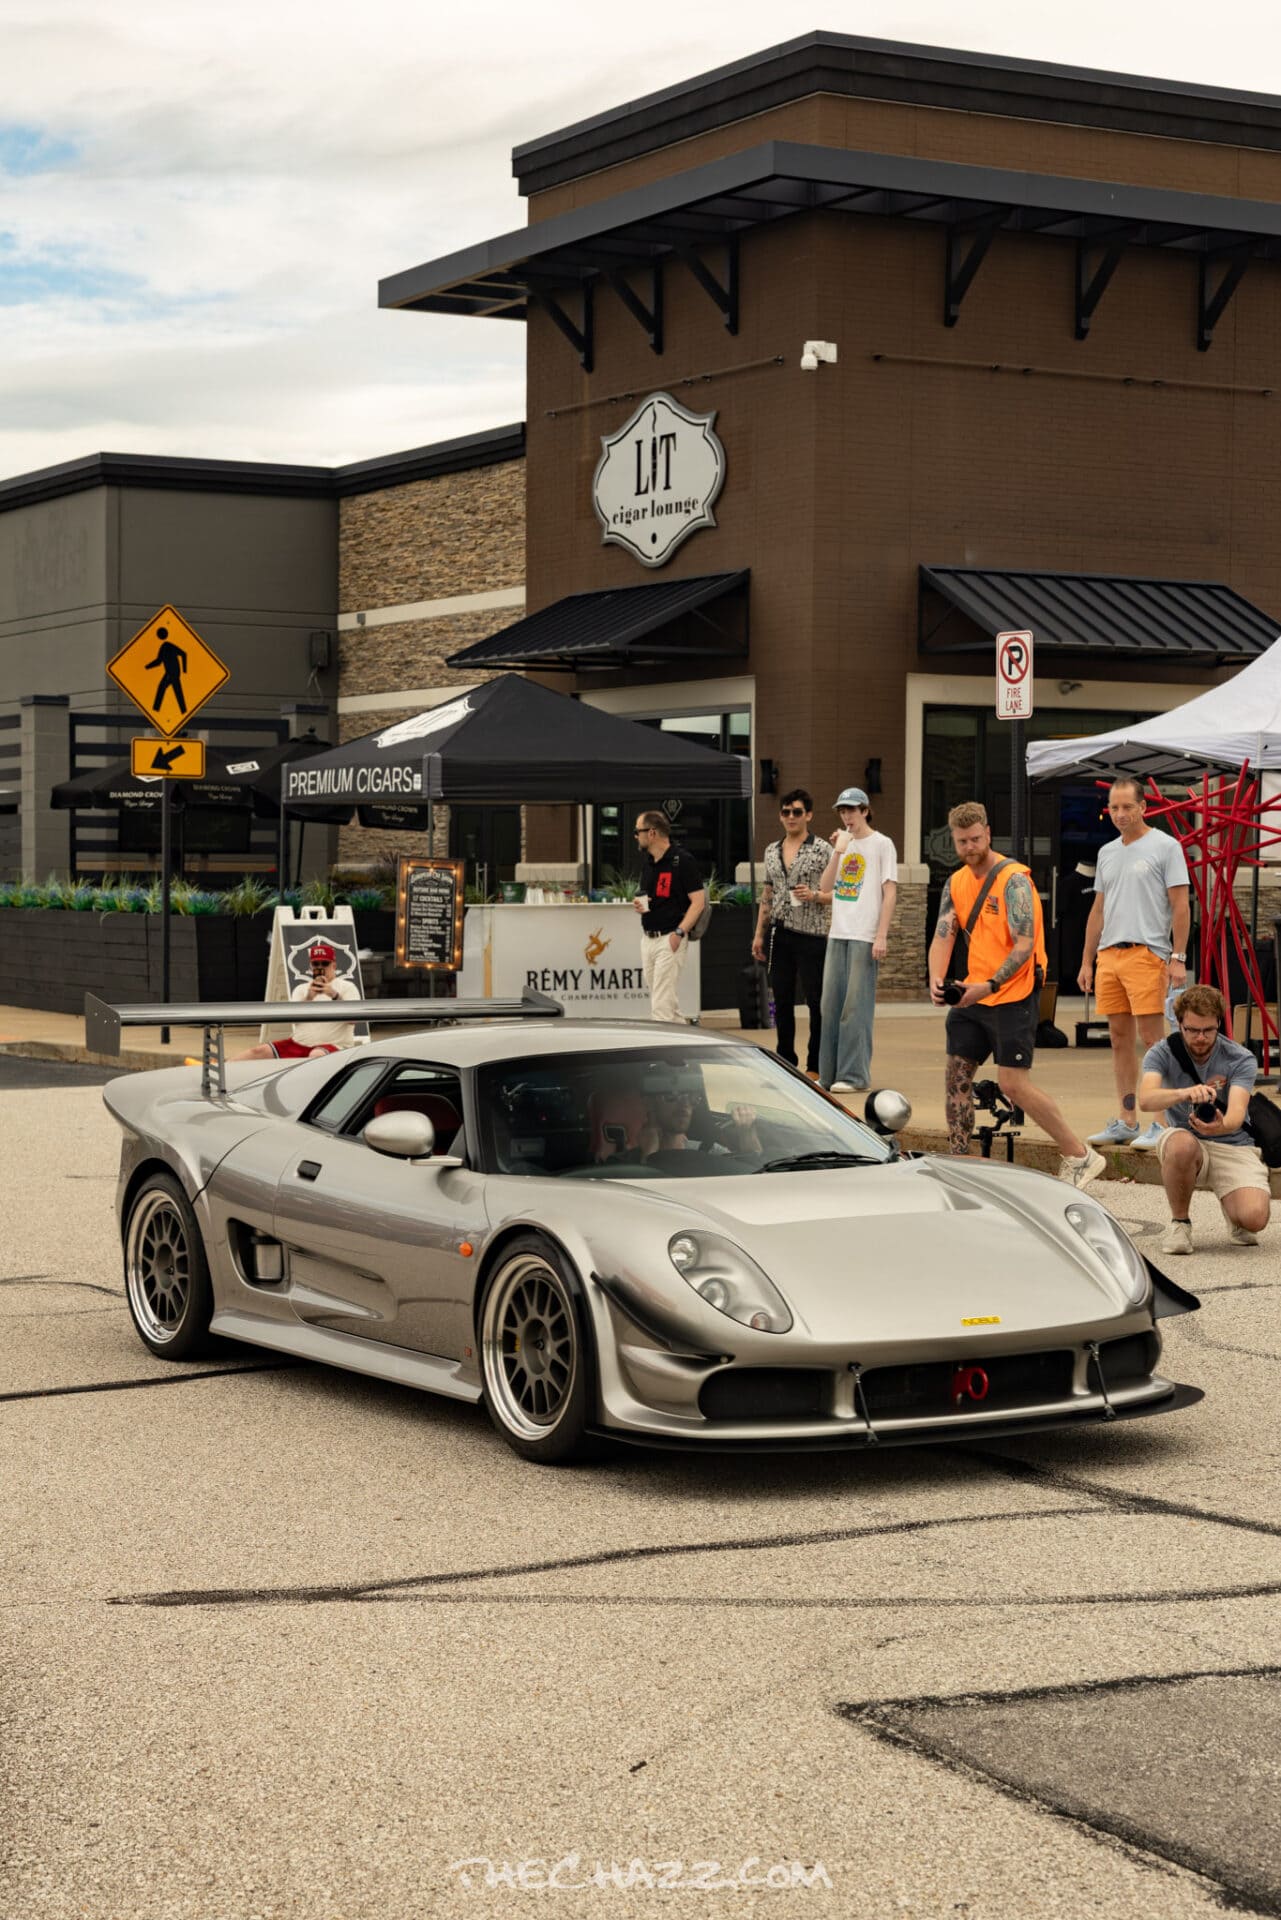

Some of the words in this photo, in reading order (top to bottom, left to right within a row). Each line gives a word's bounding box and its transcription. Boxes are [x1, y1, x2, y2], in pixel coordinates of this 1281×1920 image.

[612, 505, 648, 528] cigar
[650, 497, 699, 518] lounge
[1008, 646, 1023, 675] P
[1007, 688, 1021, 698] FIRE
[1006, 700, 1022, 711] LANE
[289, 767, 354, 796] PREMIUM
[356, 767, 413, 793] CIGARS
[109, 791, 144, 799] DIAMOND
[527, 968, 583, 991] RÉMY
[590, 968, 648, 990] MART
[561, 993, 618, 1001] CHAMPAGNE
